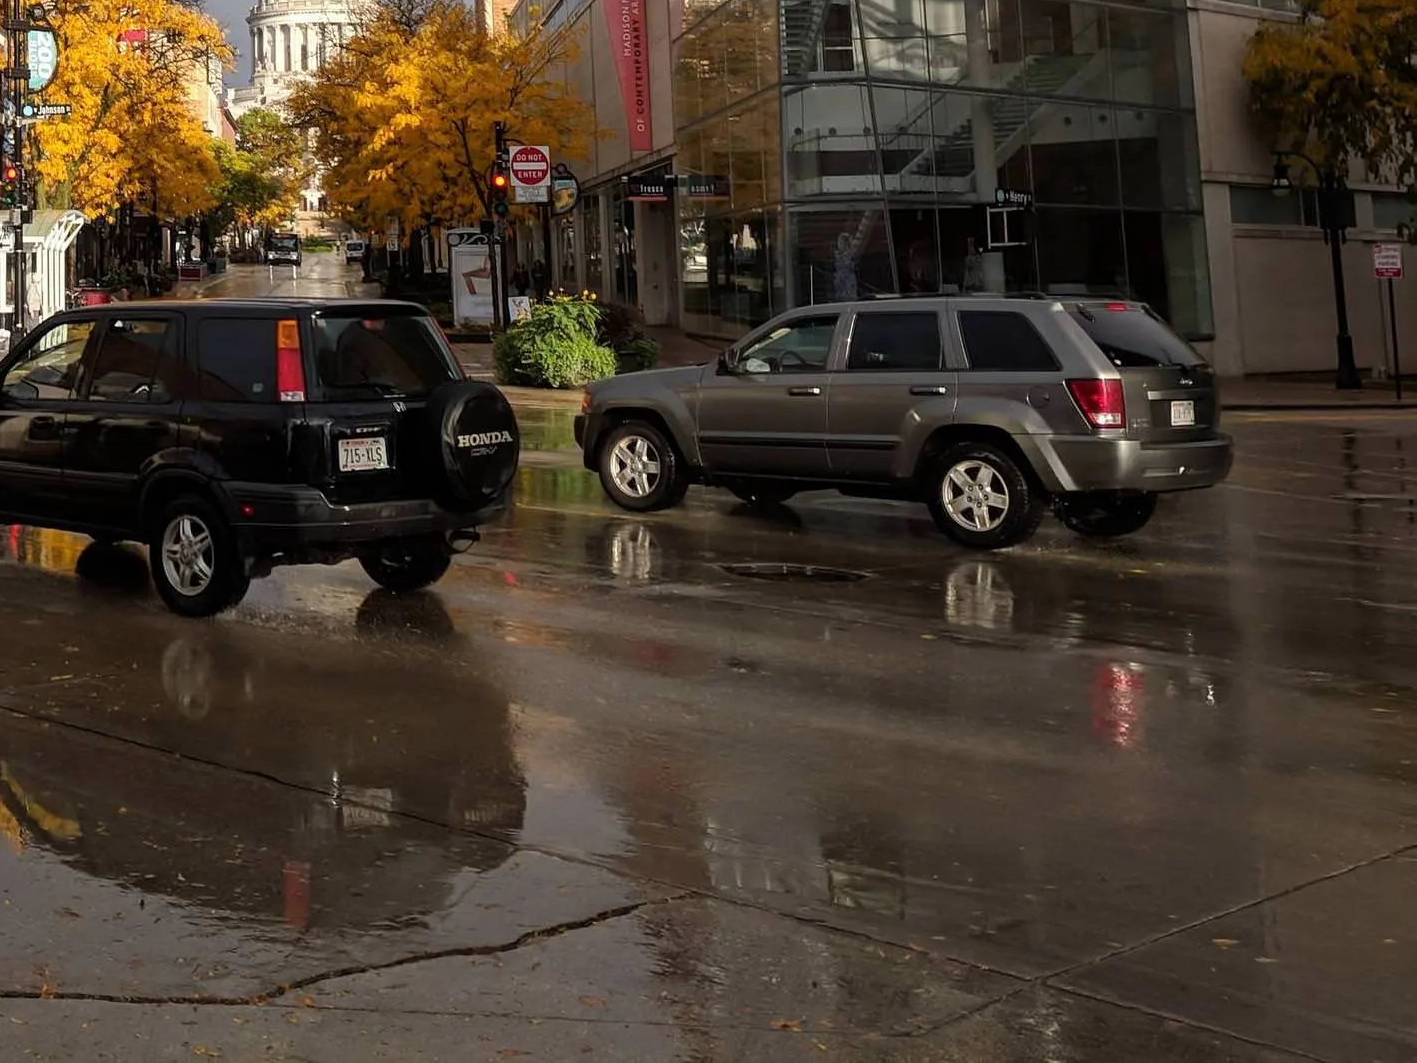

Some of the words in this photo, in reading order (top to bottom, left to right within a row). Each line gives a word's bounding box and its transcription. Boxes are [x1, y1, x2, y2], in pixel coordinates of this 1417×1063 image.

[621, 6, 632, 57] MADISON
[37, 31, 53, 79] 200
[632, 20, 644, 115] CONTEMPORARY
[38, 105, 66, 115] Johnson
[637, 119, 645, 132] OF
[457, 431, 513, 447] HONDA
